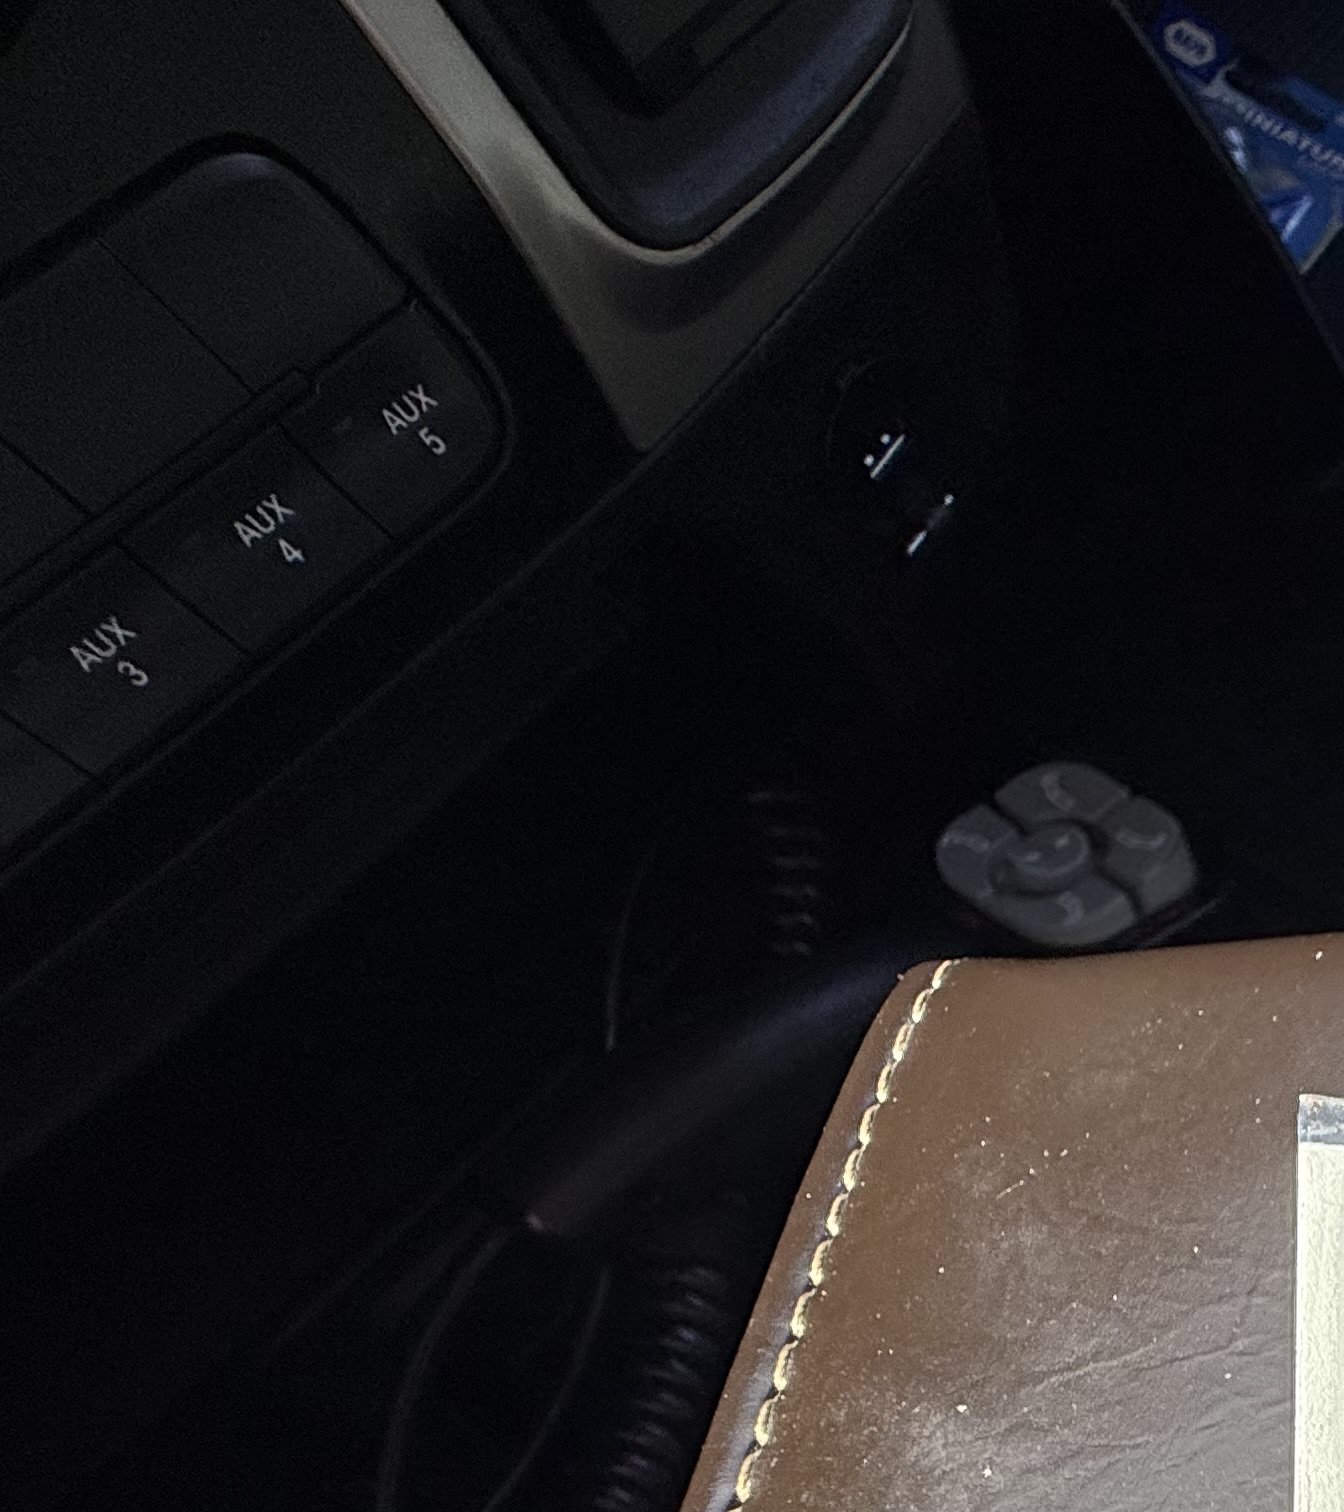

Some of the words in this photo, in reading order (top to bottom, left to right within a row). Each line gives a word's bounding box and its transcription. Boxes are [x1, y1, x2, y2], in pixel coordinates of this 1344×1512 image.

[382, 384, 438, 435] AUX
[418, 427, 446, 455] 5
[233, 494, 295, 548] AUX
[278, 538, 305, 563] 4
[70, 616, 137, 672] AUX
[117, 660, 149, 687] 3
